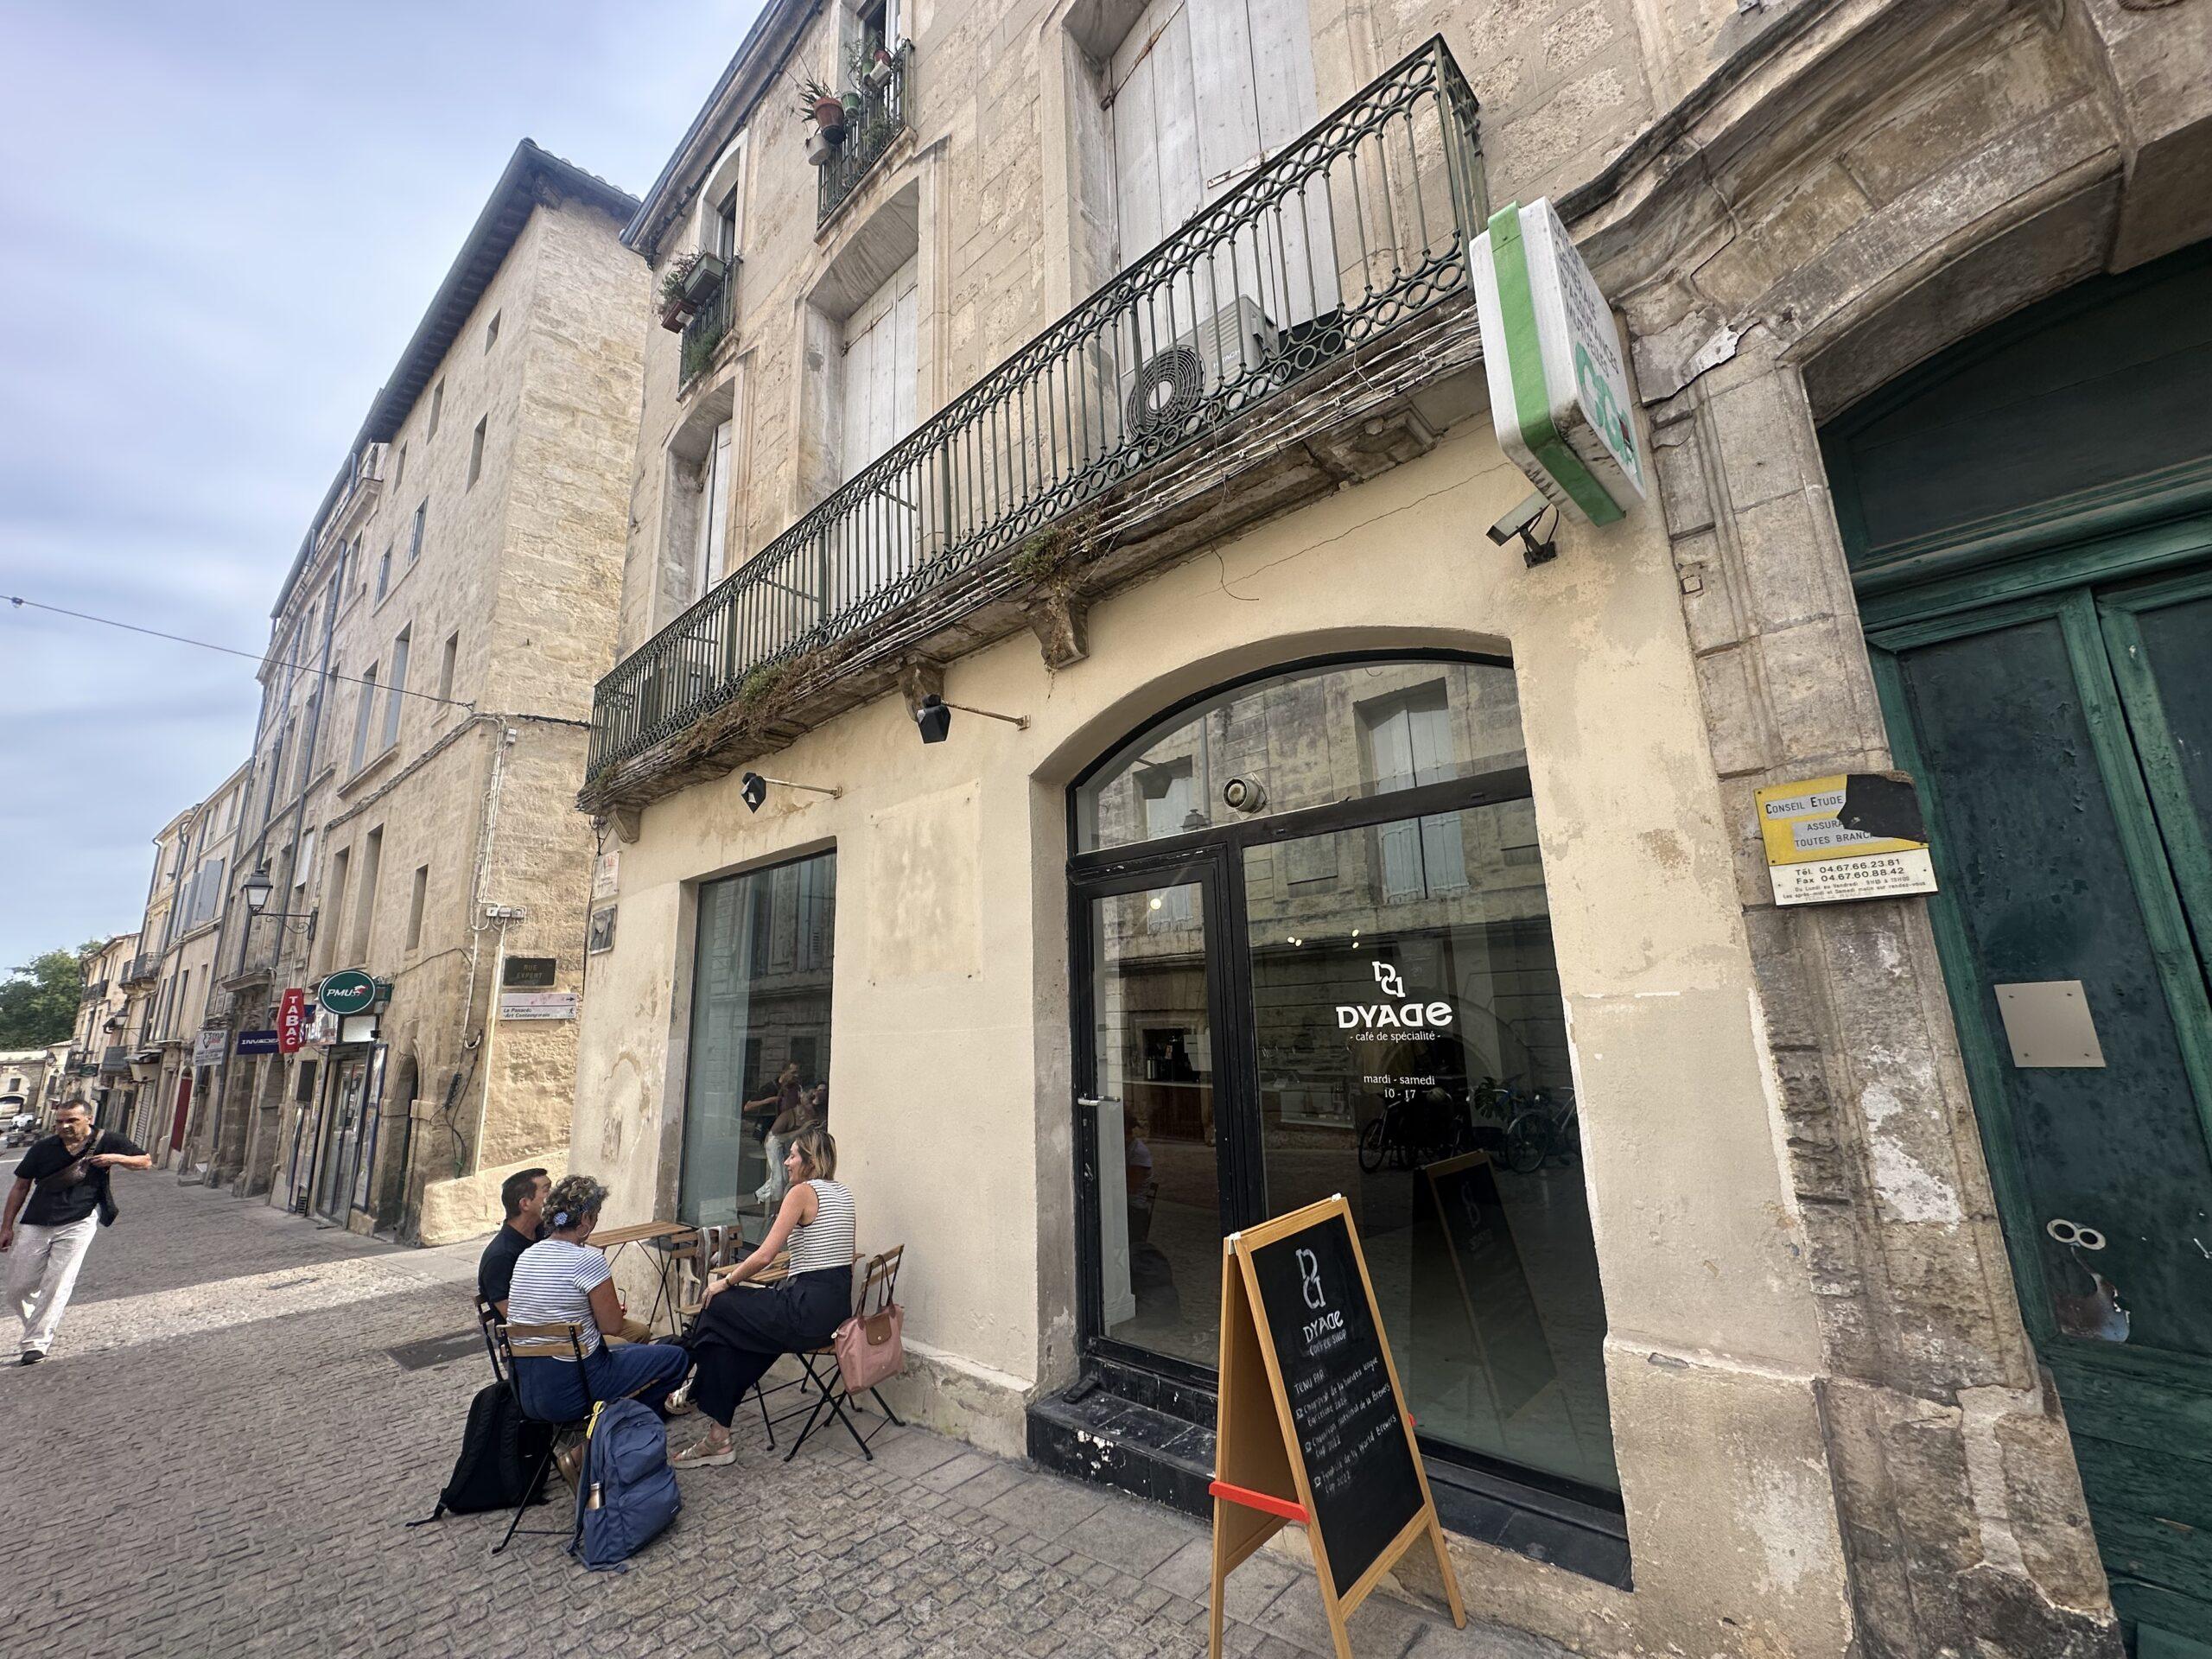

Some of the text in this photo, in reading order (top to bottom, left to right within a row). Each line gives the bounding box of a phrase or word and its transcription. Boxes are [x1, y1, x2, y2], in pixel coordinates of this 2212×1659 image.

[1795, 831, 1872, 847] TOUTES BRANC
[1820, 859, 1901, 873] 04.67.66.23.81
[1821, 867, 1904, 882] 04.67.60.88.42
[286, 995, 299, 1045] TABAC
[1356, 1031, 1374, 1040] café
[1376, 1031, 1388, 1040] de
[1390, 1030, 1435, 1044] spécialité
[1363, 1074, 1391, 1084] mardi
[1400, 1075, 1435, 1085] samedi
[1384, 1089, 1395, 1098] 10
[1405, 1090, 1416, 1099] 17
[1358, 1431, 1375, 1452] World
[1376, 1414, 1396, 1435] Brewers
